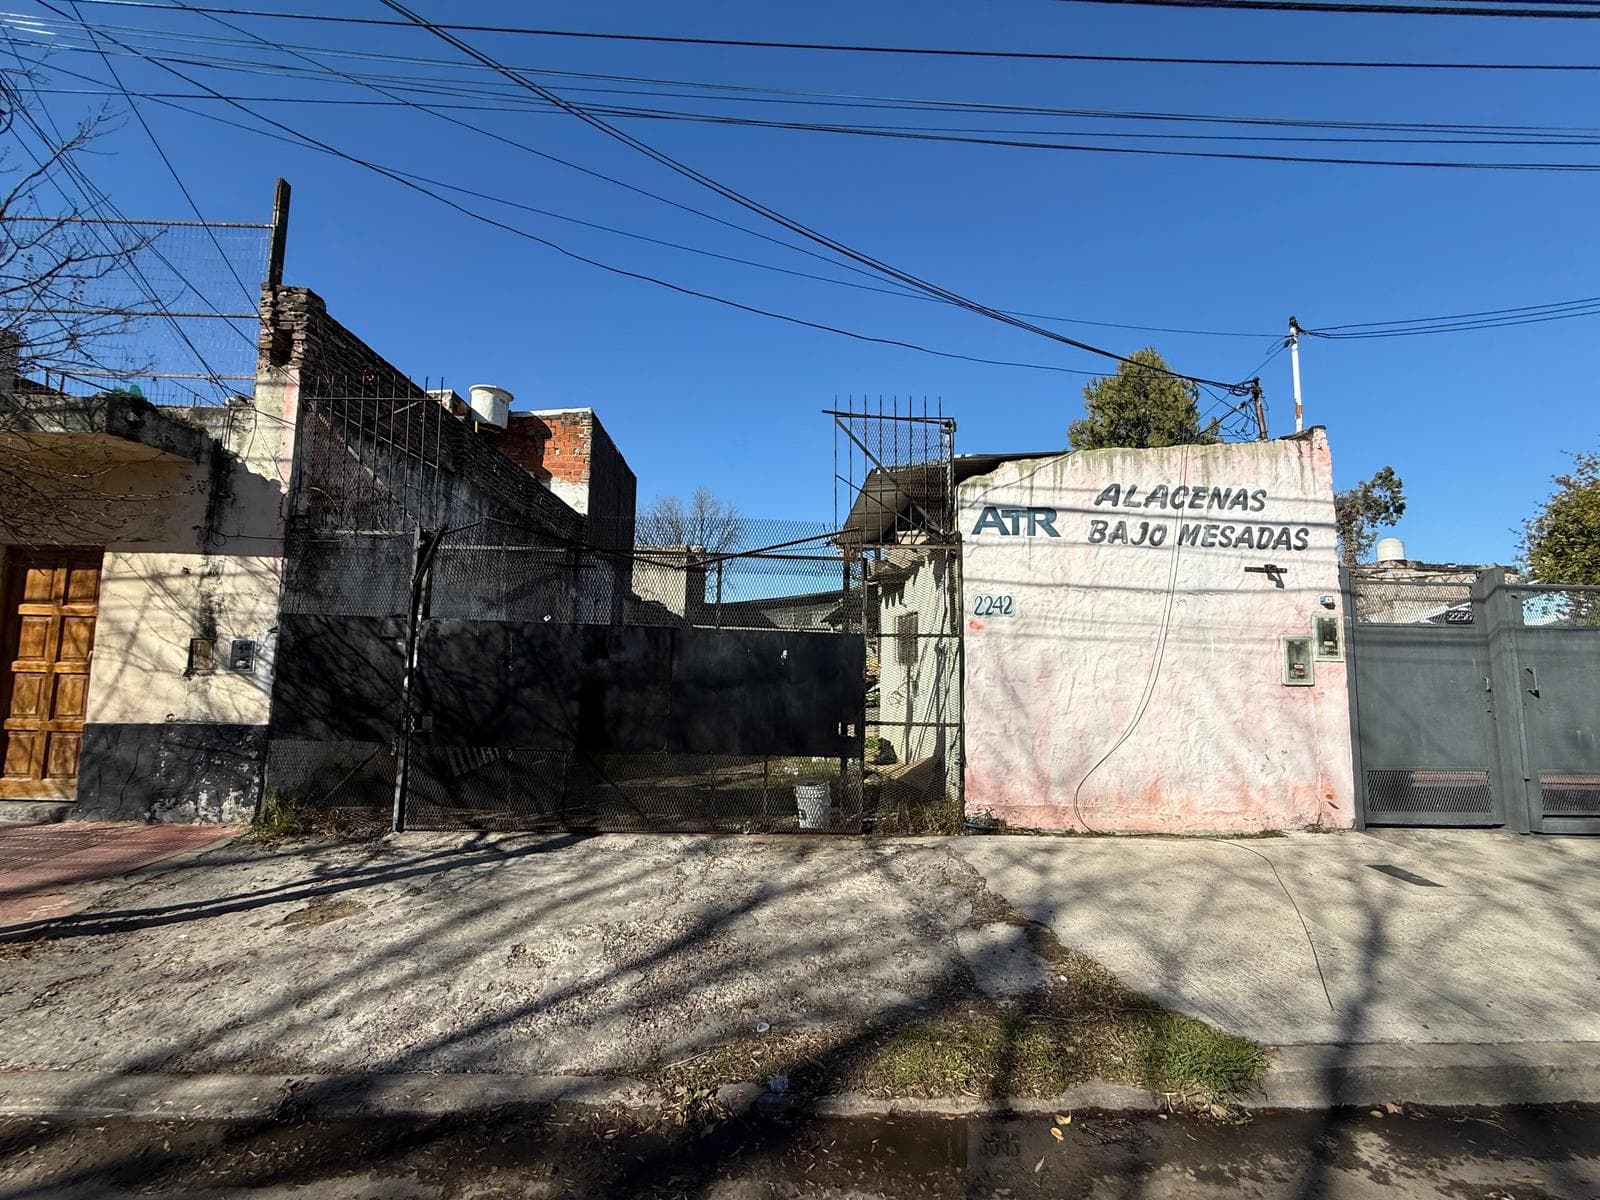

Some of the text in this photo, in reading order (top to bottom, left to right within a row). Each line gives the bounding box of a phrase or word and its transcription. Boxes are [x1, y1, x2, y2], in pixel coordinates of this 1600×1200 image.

[1093, 483, 1267, 512] ALACENAS
[971, 506, 1062, 537] ATR
[1087, 519, 1310, 551] BAJO MESADAS
[974, 595, 1013, 616] 2242
